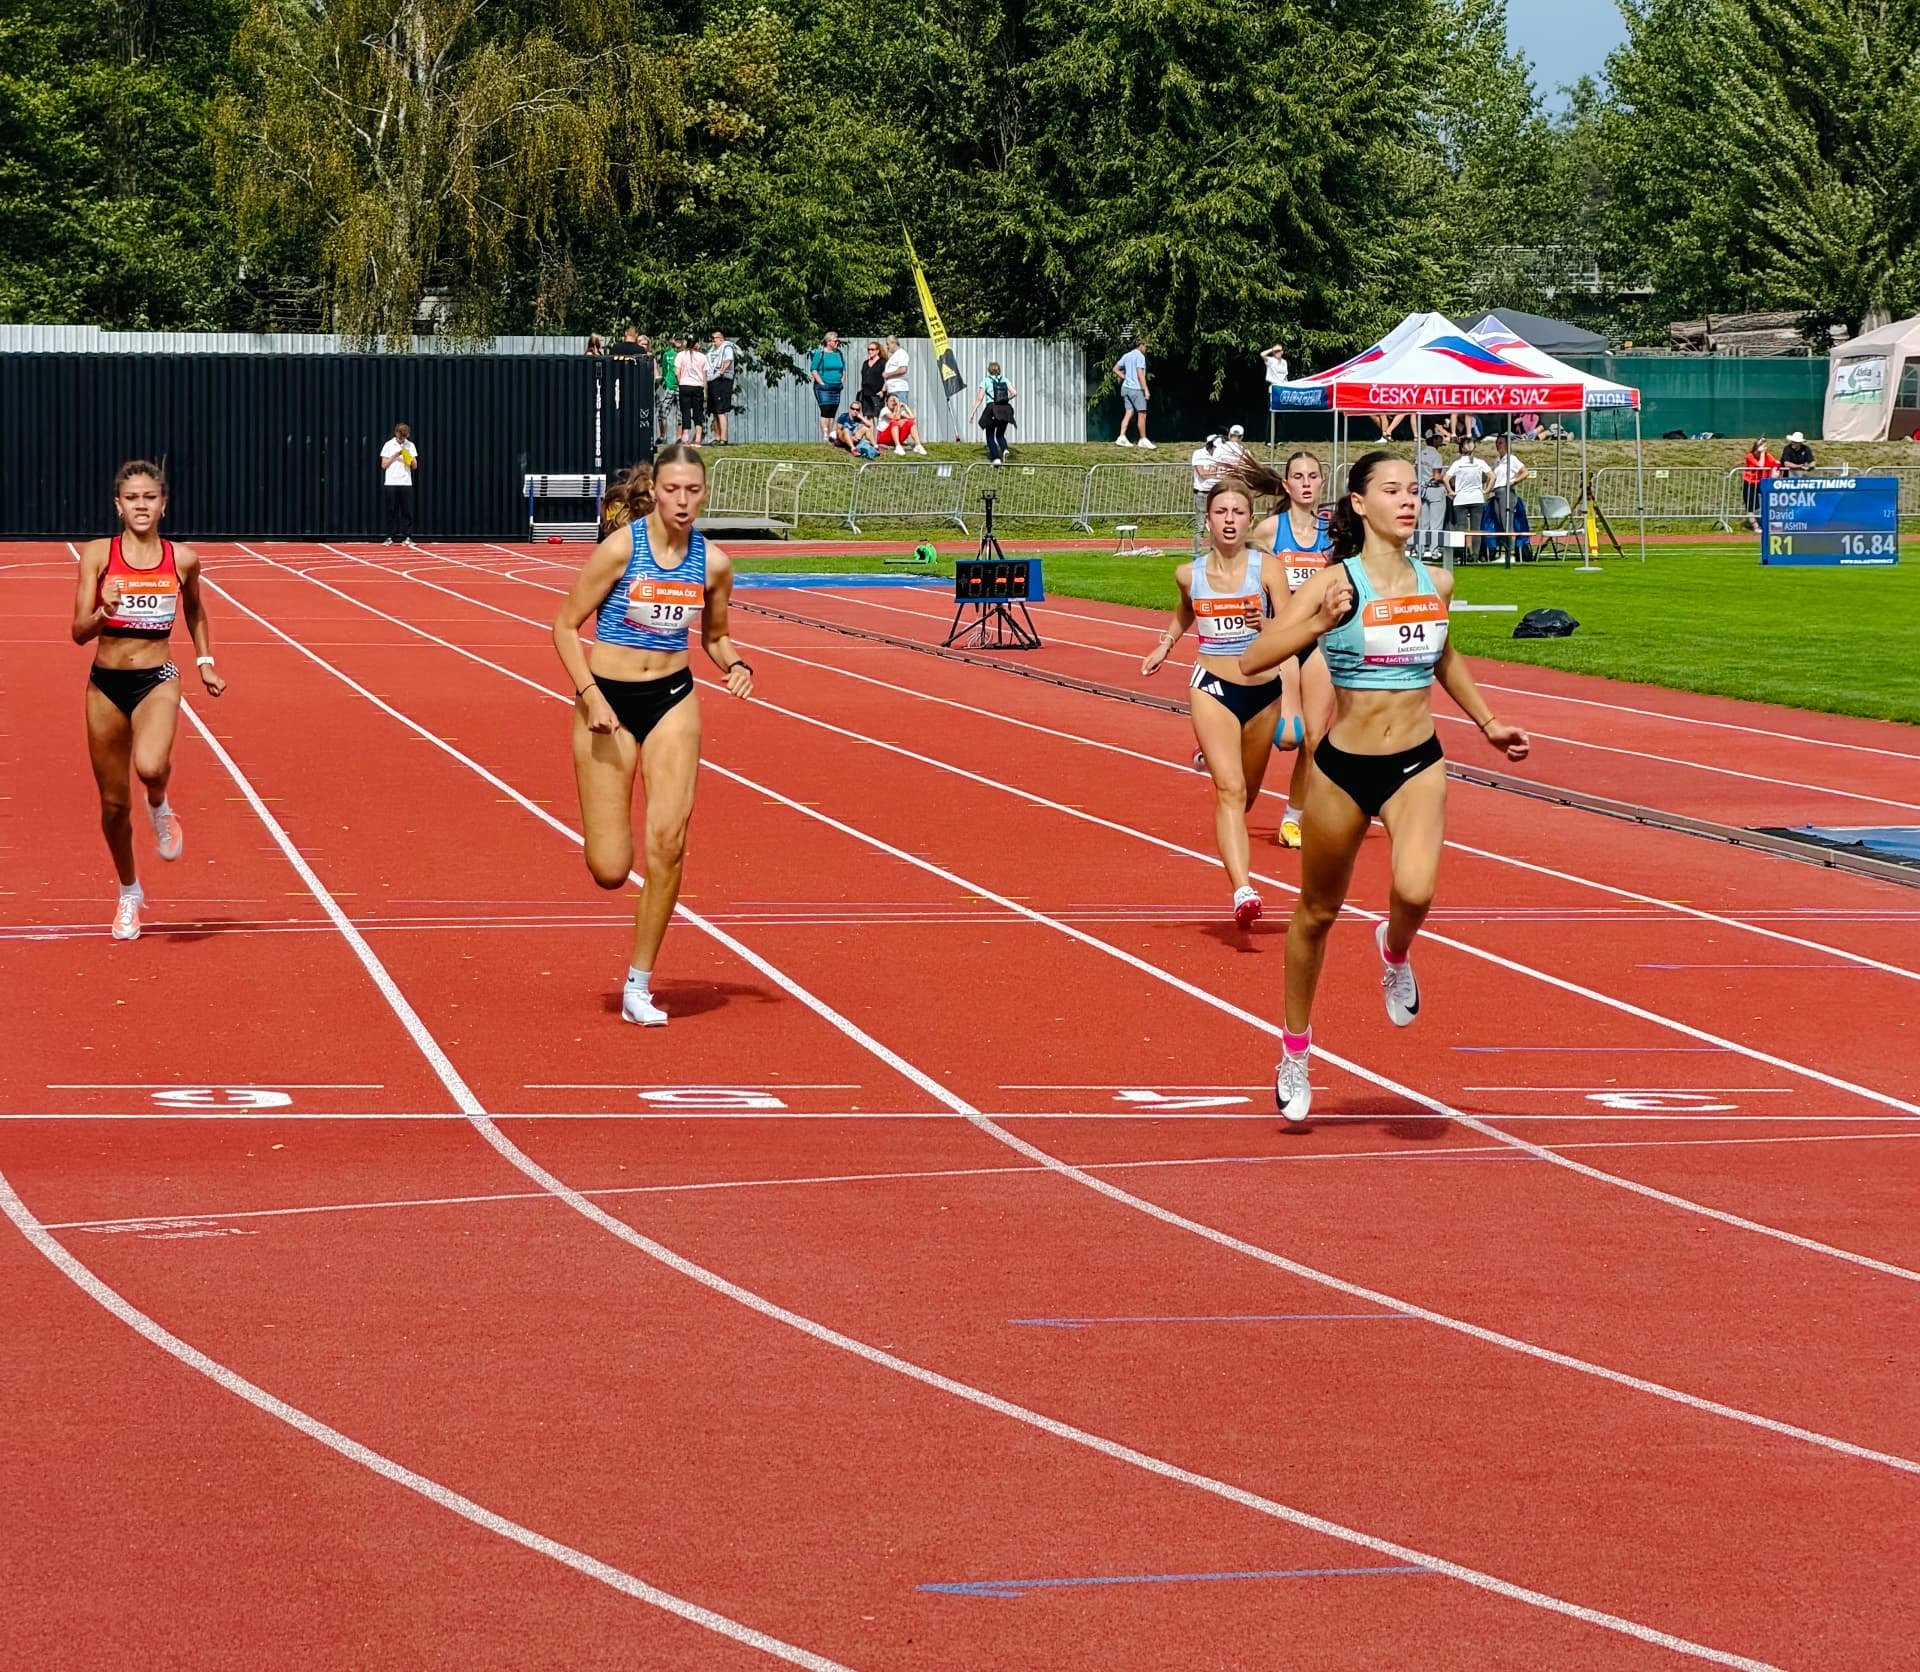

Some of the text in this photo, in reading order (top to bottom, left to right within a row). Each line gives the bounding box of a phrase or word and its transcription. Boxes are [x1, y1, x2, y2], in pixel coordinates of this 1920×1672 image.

[1368, 384, 1550, 406] ČESKÝ ATLETICKÝ SVAZ
[1773, 479, 1857, 490] ONLINETIMING
[1769, 491, 1816, 507] BOSÁK
[1769, 509, 1795, 520] David
[1769, 535, 1794, 555] R1
[1841, 534, 1896, 555] 16.84
[125, 595, 158, 609] 360
[650, 604, 684, 621] 318
[1214, 616, 1244, 631] 109
[1398, 623, 1426, 644] 94
